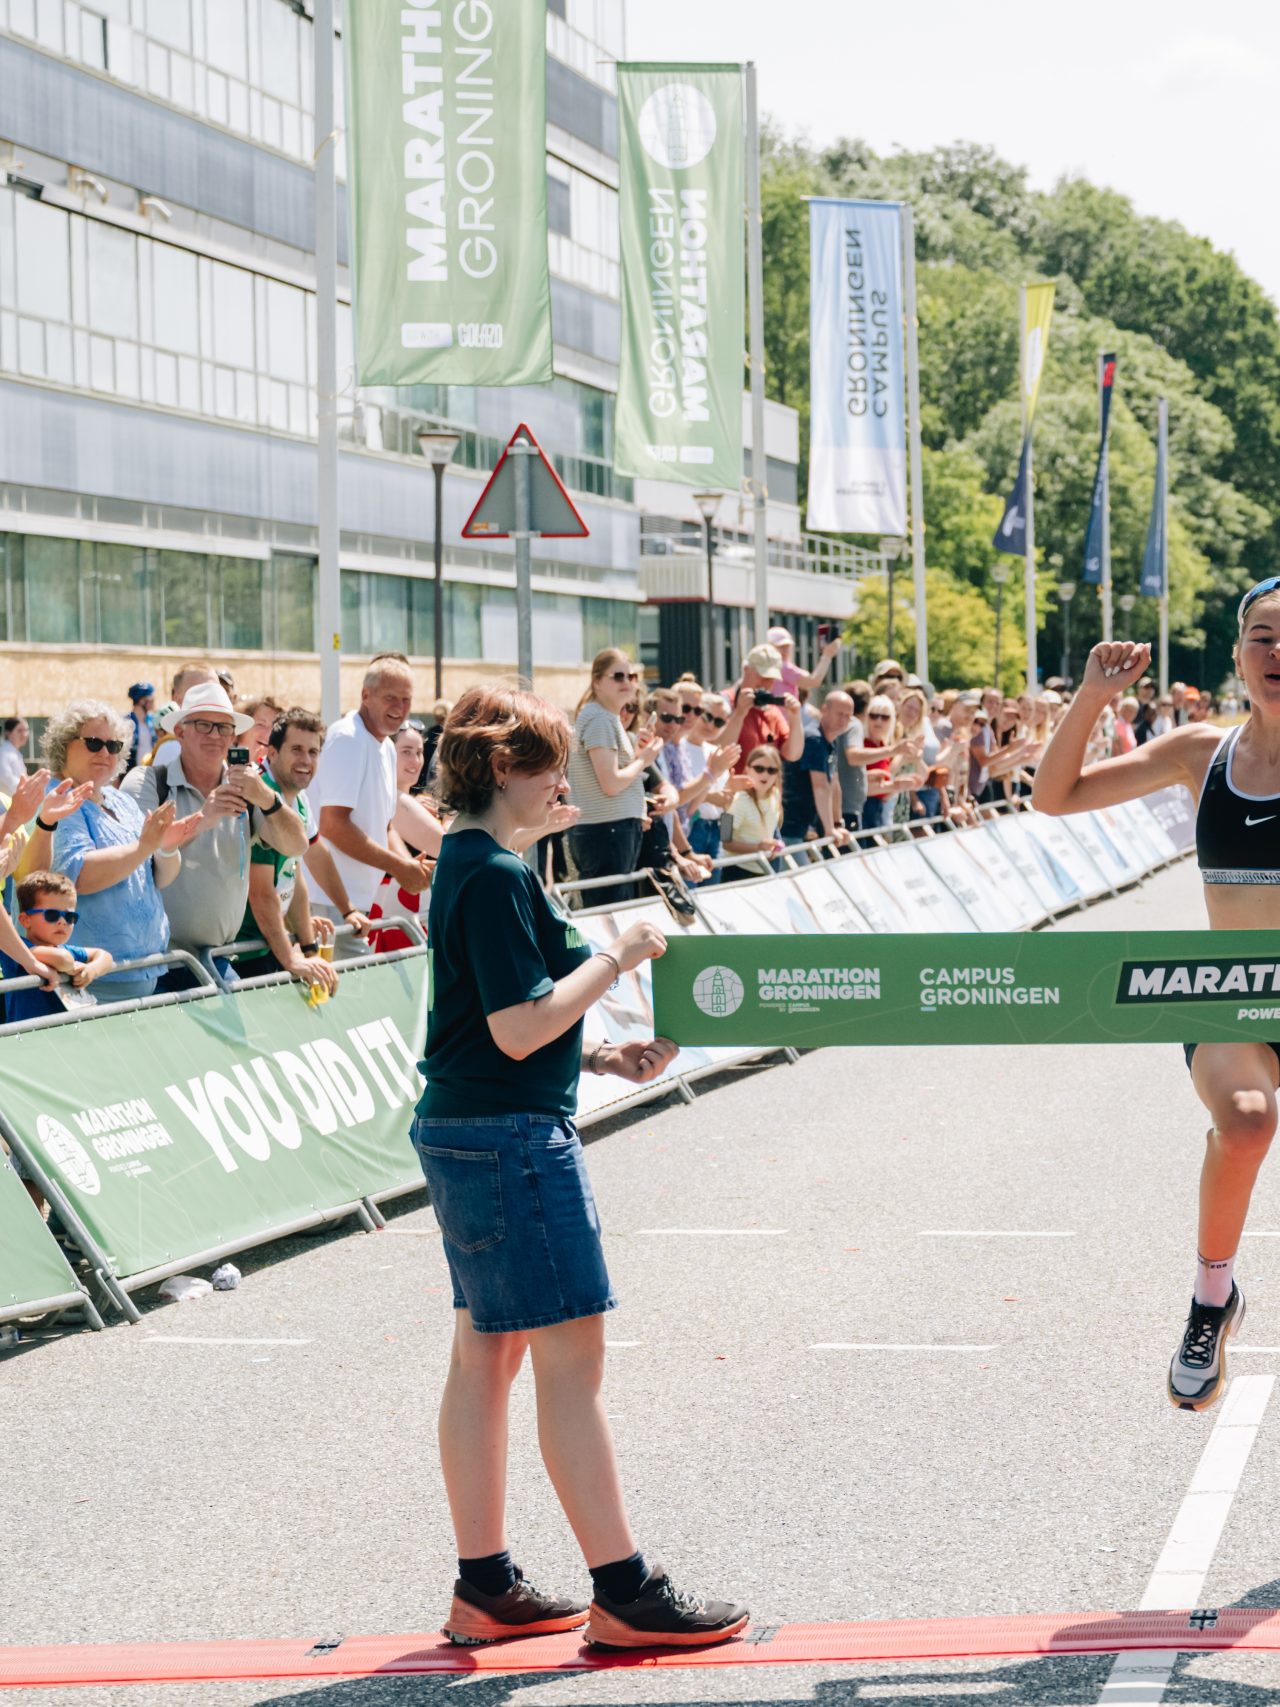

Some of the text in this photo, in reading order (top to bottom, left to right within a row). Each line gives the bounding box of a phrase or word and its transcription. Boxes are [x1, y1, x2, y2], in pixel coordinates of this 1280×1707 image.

[401, 0, 449, 282] MARATH
[453, 0, 498, 279] GRONING
[757, 967, 881, 984] MARATHON
[758, 984, 881, 1001] GRONINGEN
[919, 967, 1016, 986] CAMPUS
[919, 987, 1060, 1006] GRONINGEN
[164, 1015, 429, 1174] YOU DID IT!
[71, 1097, 158, 1137] MARATHON
[90, 1122, 174, 1161] GRONINGEN
